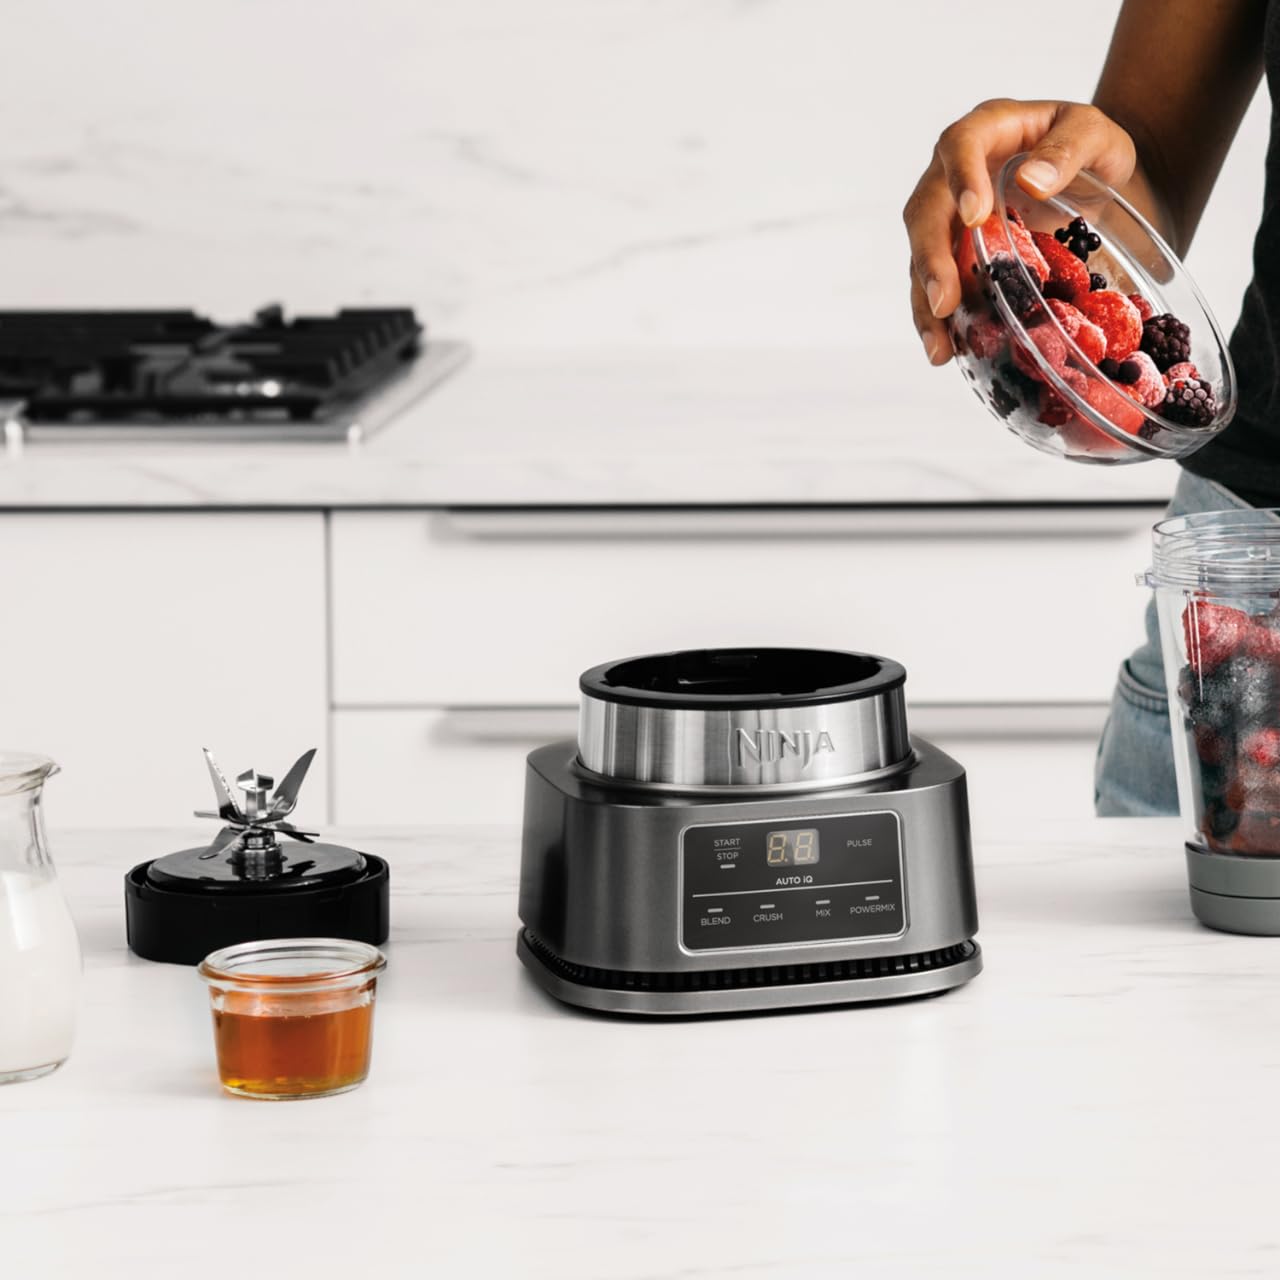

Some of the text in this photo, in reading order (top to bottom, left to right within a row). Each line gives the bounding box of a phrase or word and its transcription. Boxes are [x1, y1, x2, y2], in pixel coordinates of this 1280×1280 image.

[736, 728, 835, 770] NINJA
[713, 838, 741, 847] START
[847, 839, 872, 848] PULSE
[717, 852, 739, 860] STOP
[776, 876, 801, 885] AUTO
[816, 908, 831, 917] MIX
[850, 904, 896, 914] POWERMIX
[701, 916, 731, 926] BLEND
[753, 913, 783, 922] CRUSH
